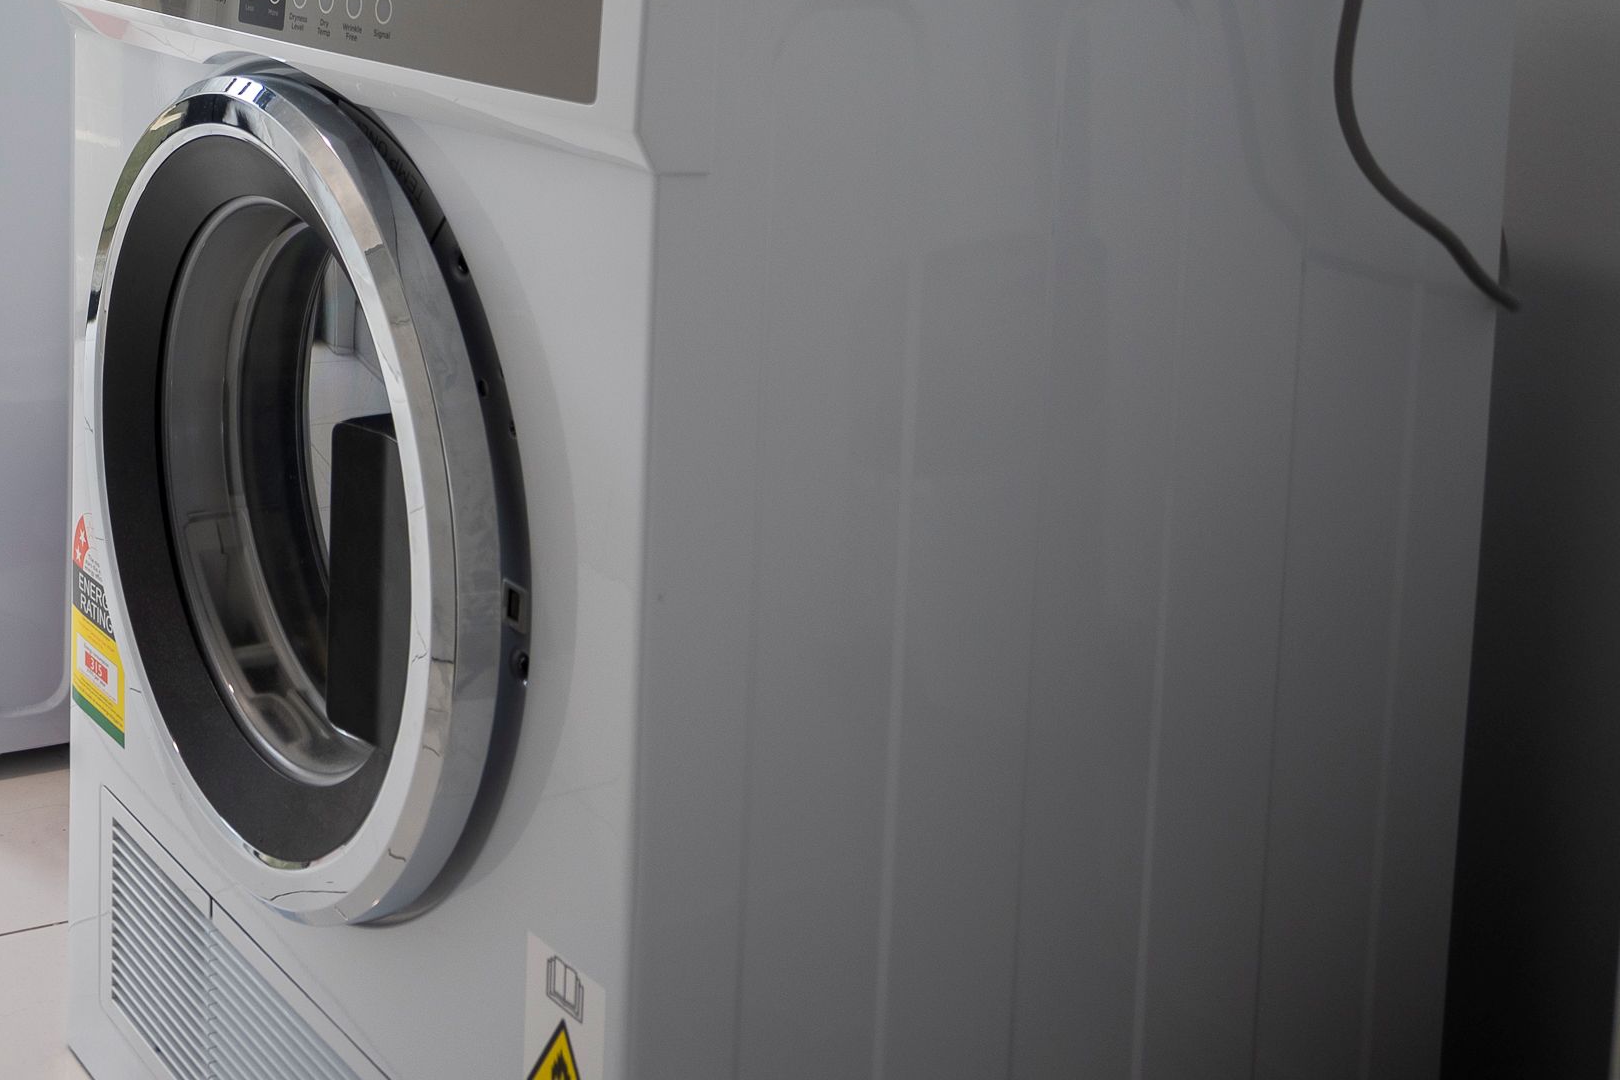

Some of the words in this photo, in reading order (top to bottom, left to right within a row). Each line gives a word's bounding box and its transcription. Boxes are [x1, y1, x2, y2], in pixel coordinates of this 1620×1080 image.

[289, 12, 307, 22] Dryness
[292, 22, 304, 31] Level
[320, 18, 329, 28] Dry
[318, 27, 330, 37] Temp
[343, 23, 362, 34] Wrinkle
[346, 32, 357, 42] Free
[373, 29, 390, 40] Signal
[79, 572, 110, 610] ENERG
[81, 593, 113, 634] RATING
[90, 658, 103, 676] 315
